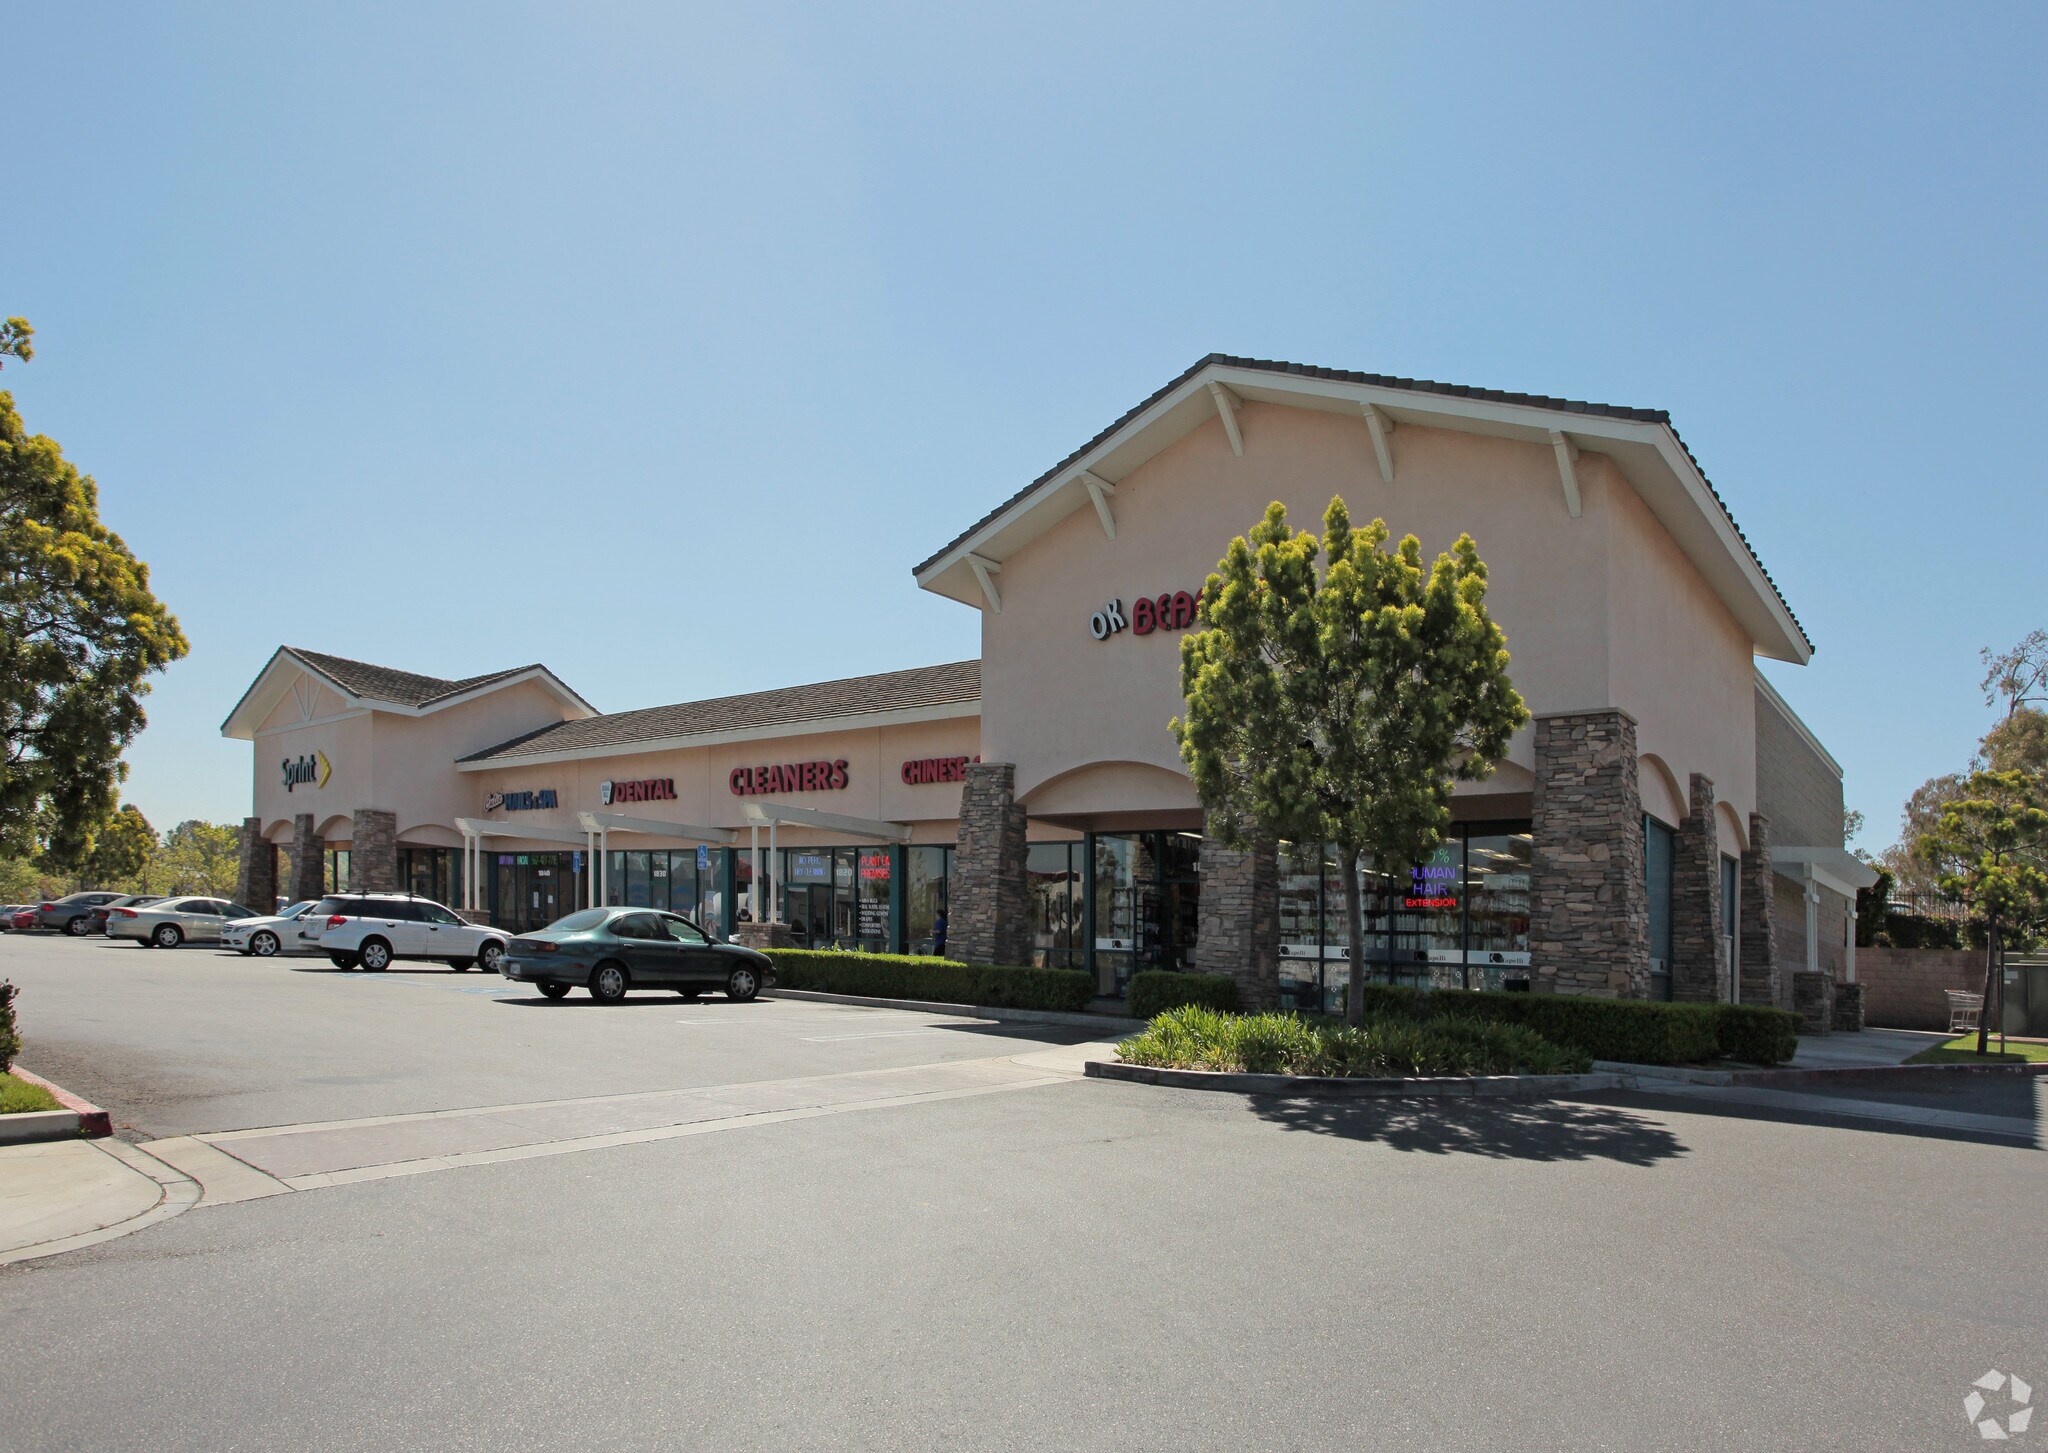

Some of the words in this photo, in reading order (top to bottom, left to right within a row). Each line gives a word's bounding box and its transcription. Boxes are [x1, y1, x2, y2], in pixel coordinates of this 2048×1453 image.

[1090, 598, 1128, 641] OK
[1132, 587, 1203, 636] BEA
[282, 754, 317, 793] Sprint
[729, 759, 849, 796] CLEANERS
[901, 756, 969, 785] CHINESE
[505, 791, 533, 811] NAILS
[539, 789, 558, 810] SPA
[614, 778, 677, 802] DENTAL
[836, 868, 853, 877] 1820
[1413, 882, 1448, 896] HAIR
[1405, 898, 1457, 907] EXTENSION
